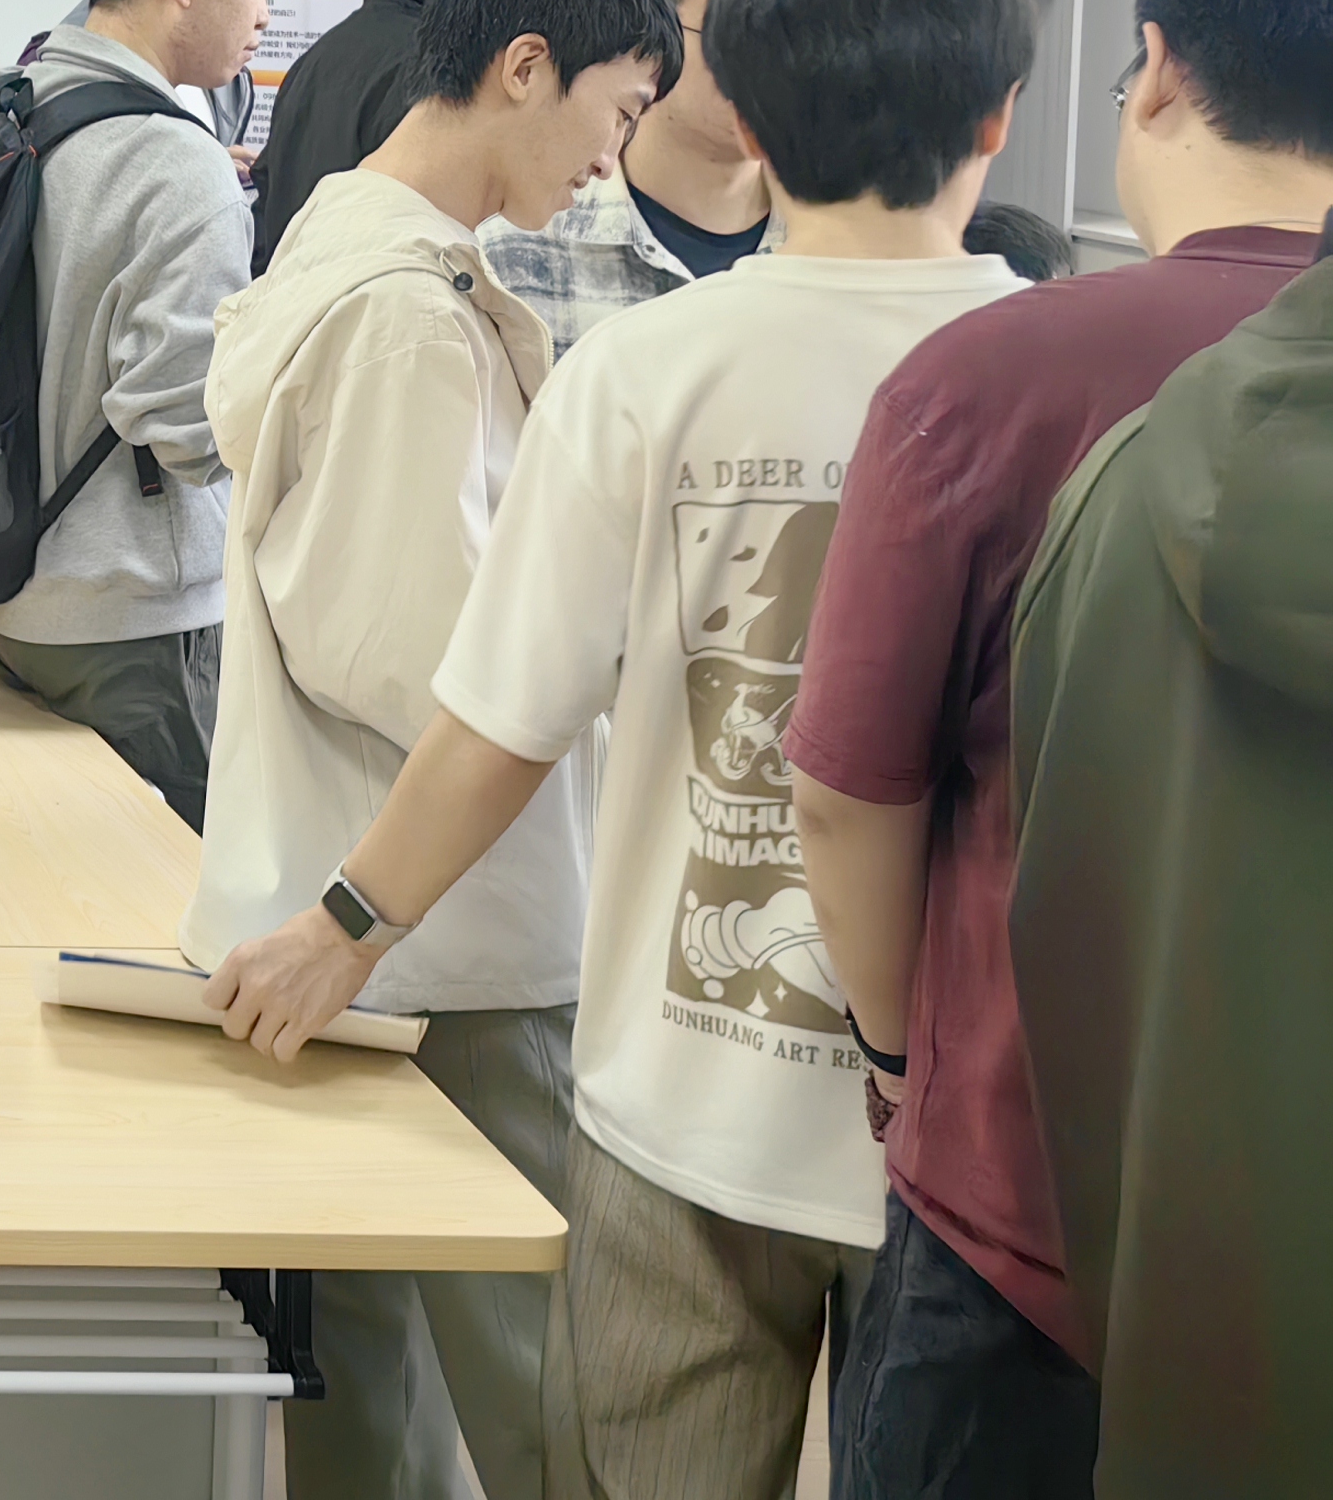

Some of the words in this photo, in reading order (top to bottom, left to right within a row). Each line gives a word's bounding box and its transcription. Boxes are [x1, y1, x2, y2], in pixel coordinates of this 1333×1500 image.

[677, 460, 699, 490] A
[713, 458, 805, 489] DEER
[823, 460, 851, 490] O
[662, 1000, 765, 1051] DUNHUANG
[773, 1038, 820, 1065] ART
